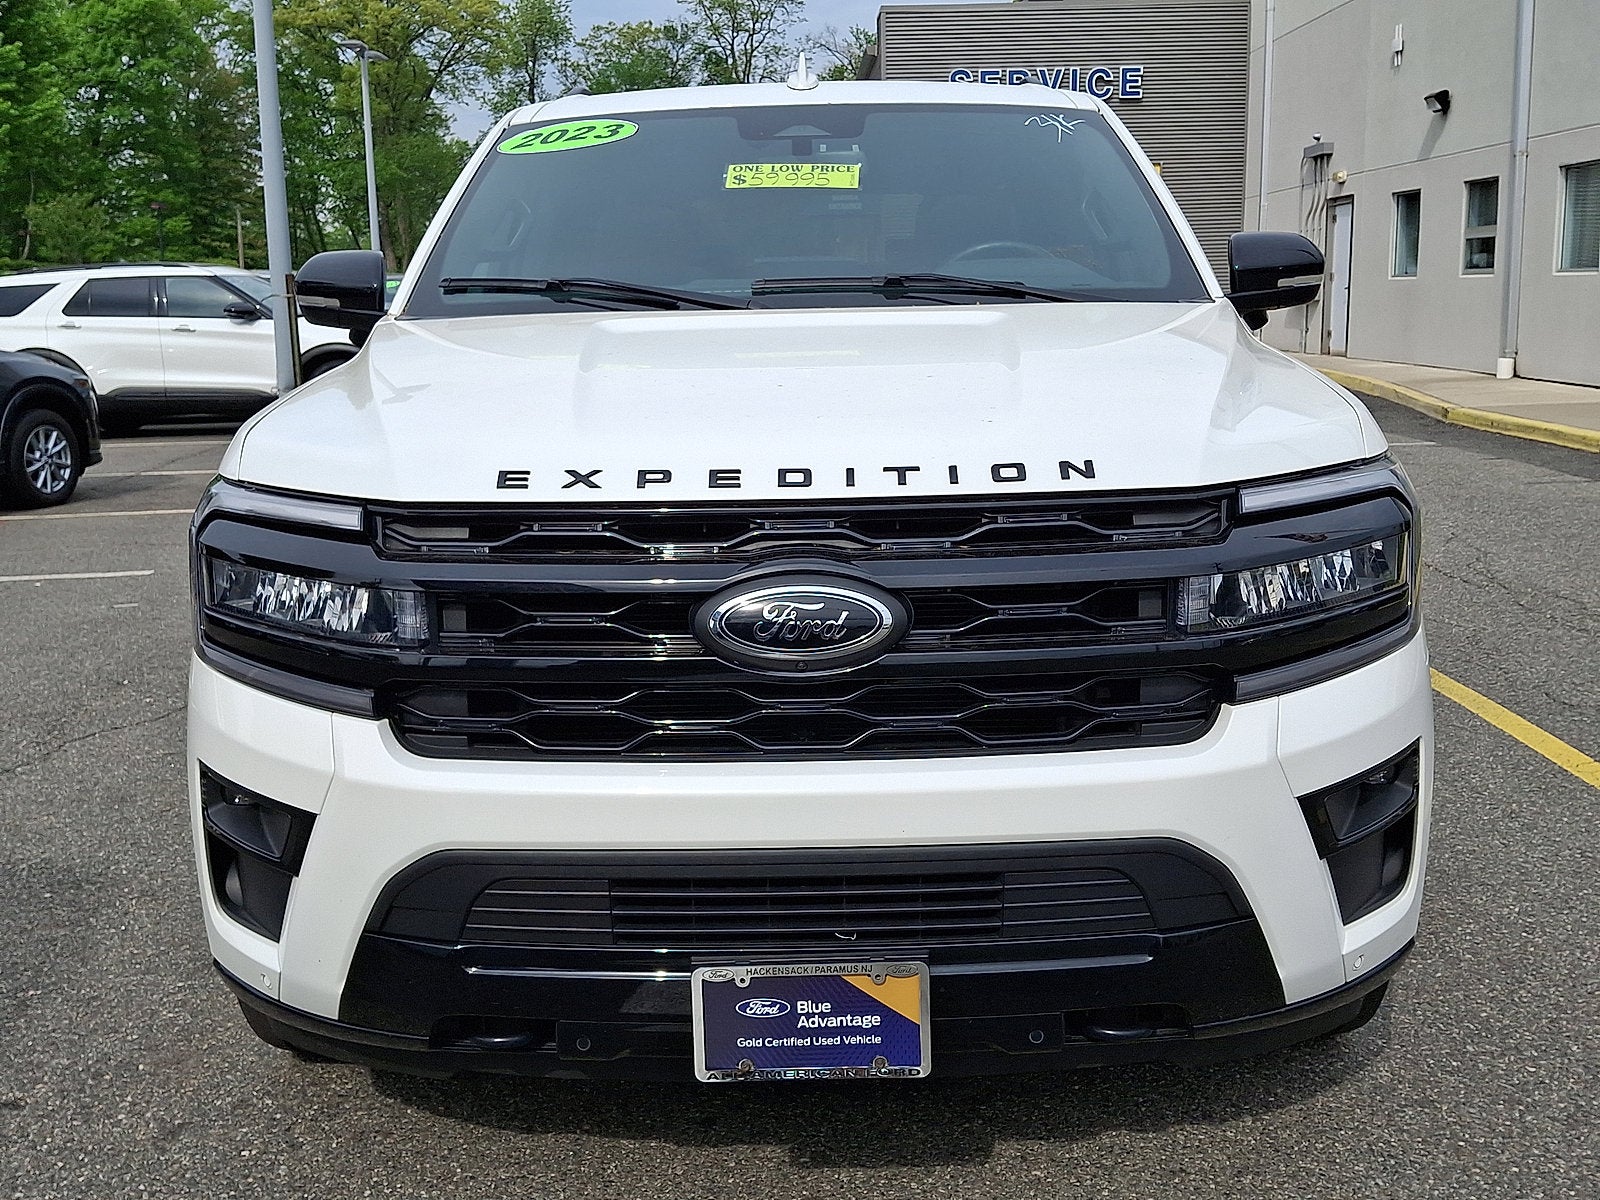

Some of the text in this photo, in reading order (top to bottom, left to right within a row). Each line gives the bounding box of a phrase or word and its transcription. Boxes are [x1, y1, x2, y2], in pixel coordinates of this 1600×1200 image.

[510, 124, 625, 150] 2023
[732, 165, 855, 173] ONE LOW PRICE
[496, 459, 1096, 490] EXPEDITION
[753, 601, 847, 641] Ford
[708, 970, 729, 979] Ford
[861, 965, 873, 973] NJ
[746, 1000, 780, 1015] Ford
[797, 1000, 831, 1014] Blue
[797, 1013, 881, 1029] Advantage
[736, 1035, 882, 1048] Gold Certified Used Vehicle
[750, 1067, 857, 1080] AMERICAN
[865, 1067, 921, 1079] FORD
